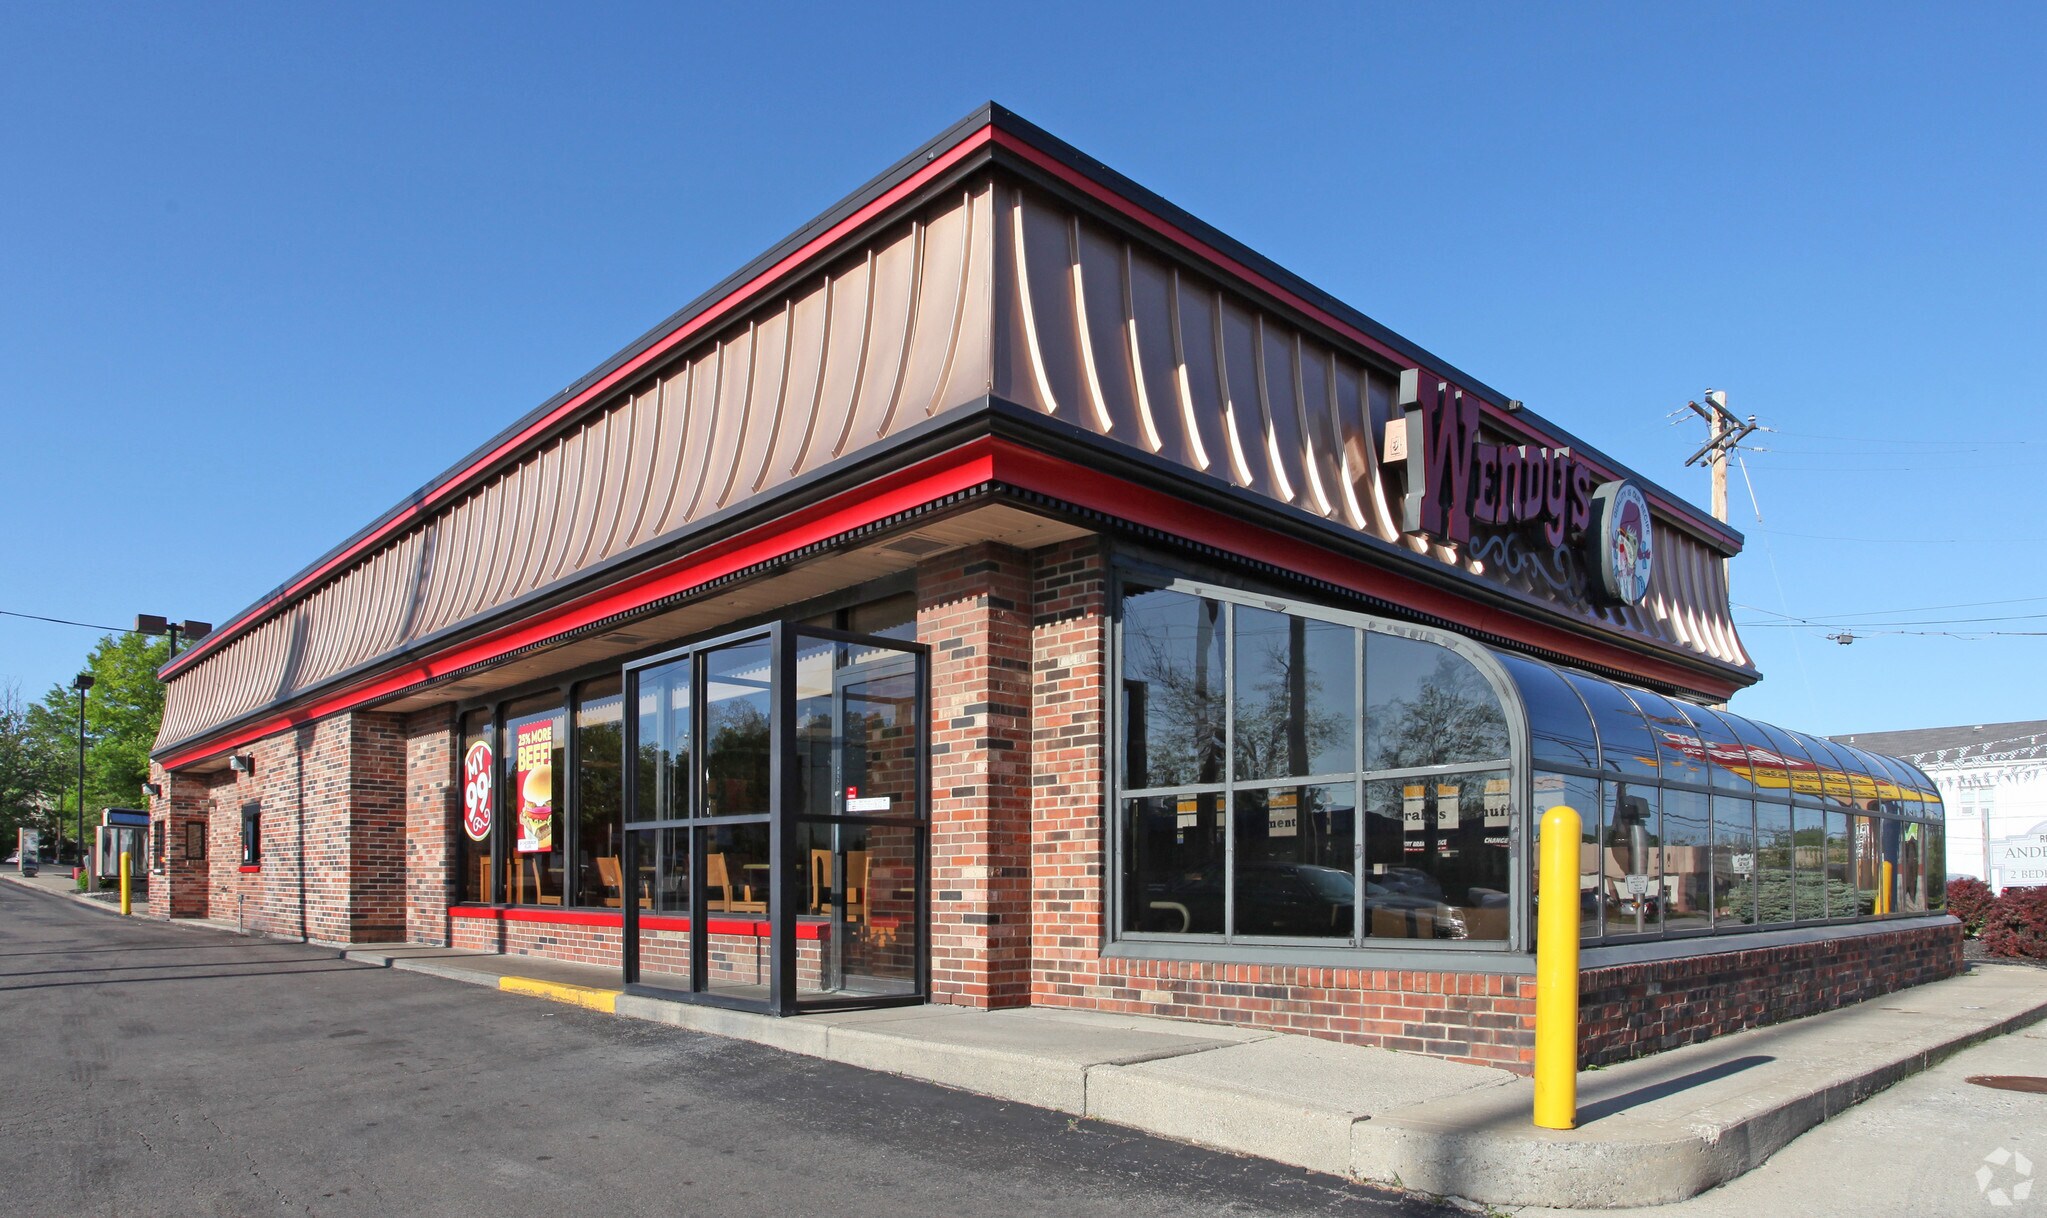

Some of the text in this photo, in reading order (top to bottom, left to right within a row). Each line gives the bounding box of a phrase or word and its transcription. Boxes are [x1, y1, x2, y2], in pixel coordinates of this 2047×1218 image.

[1613, 491, 1626, 518] QUALITY
[1640, 503, 1651, 535] RECIPE
[518, 726, 551, 747] 25% MORE
[467, 746, 484, 781] MY
[2010, 870, 2016, 879] 2
